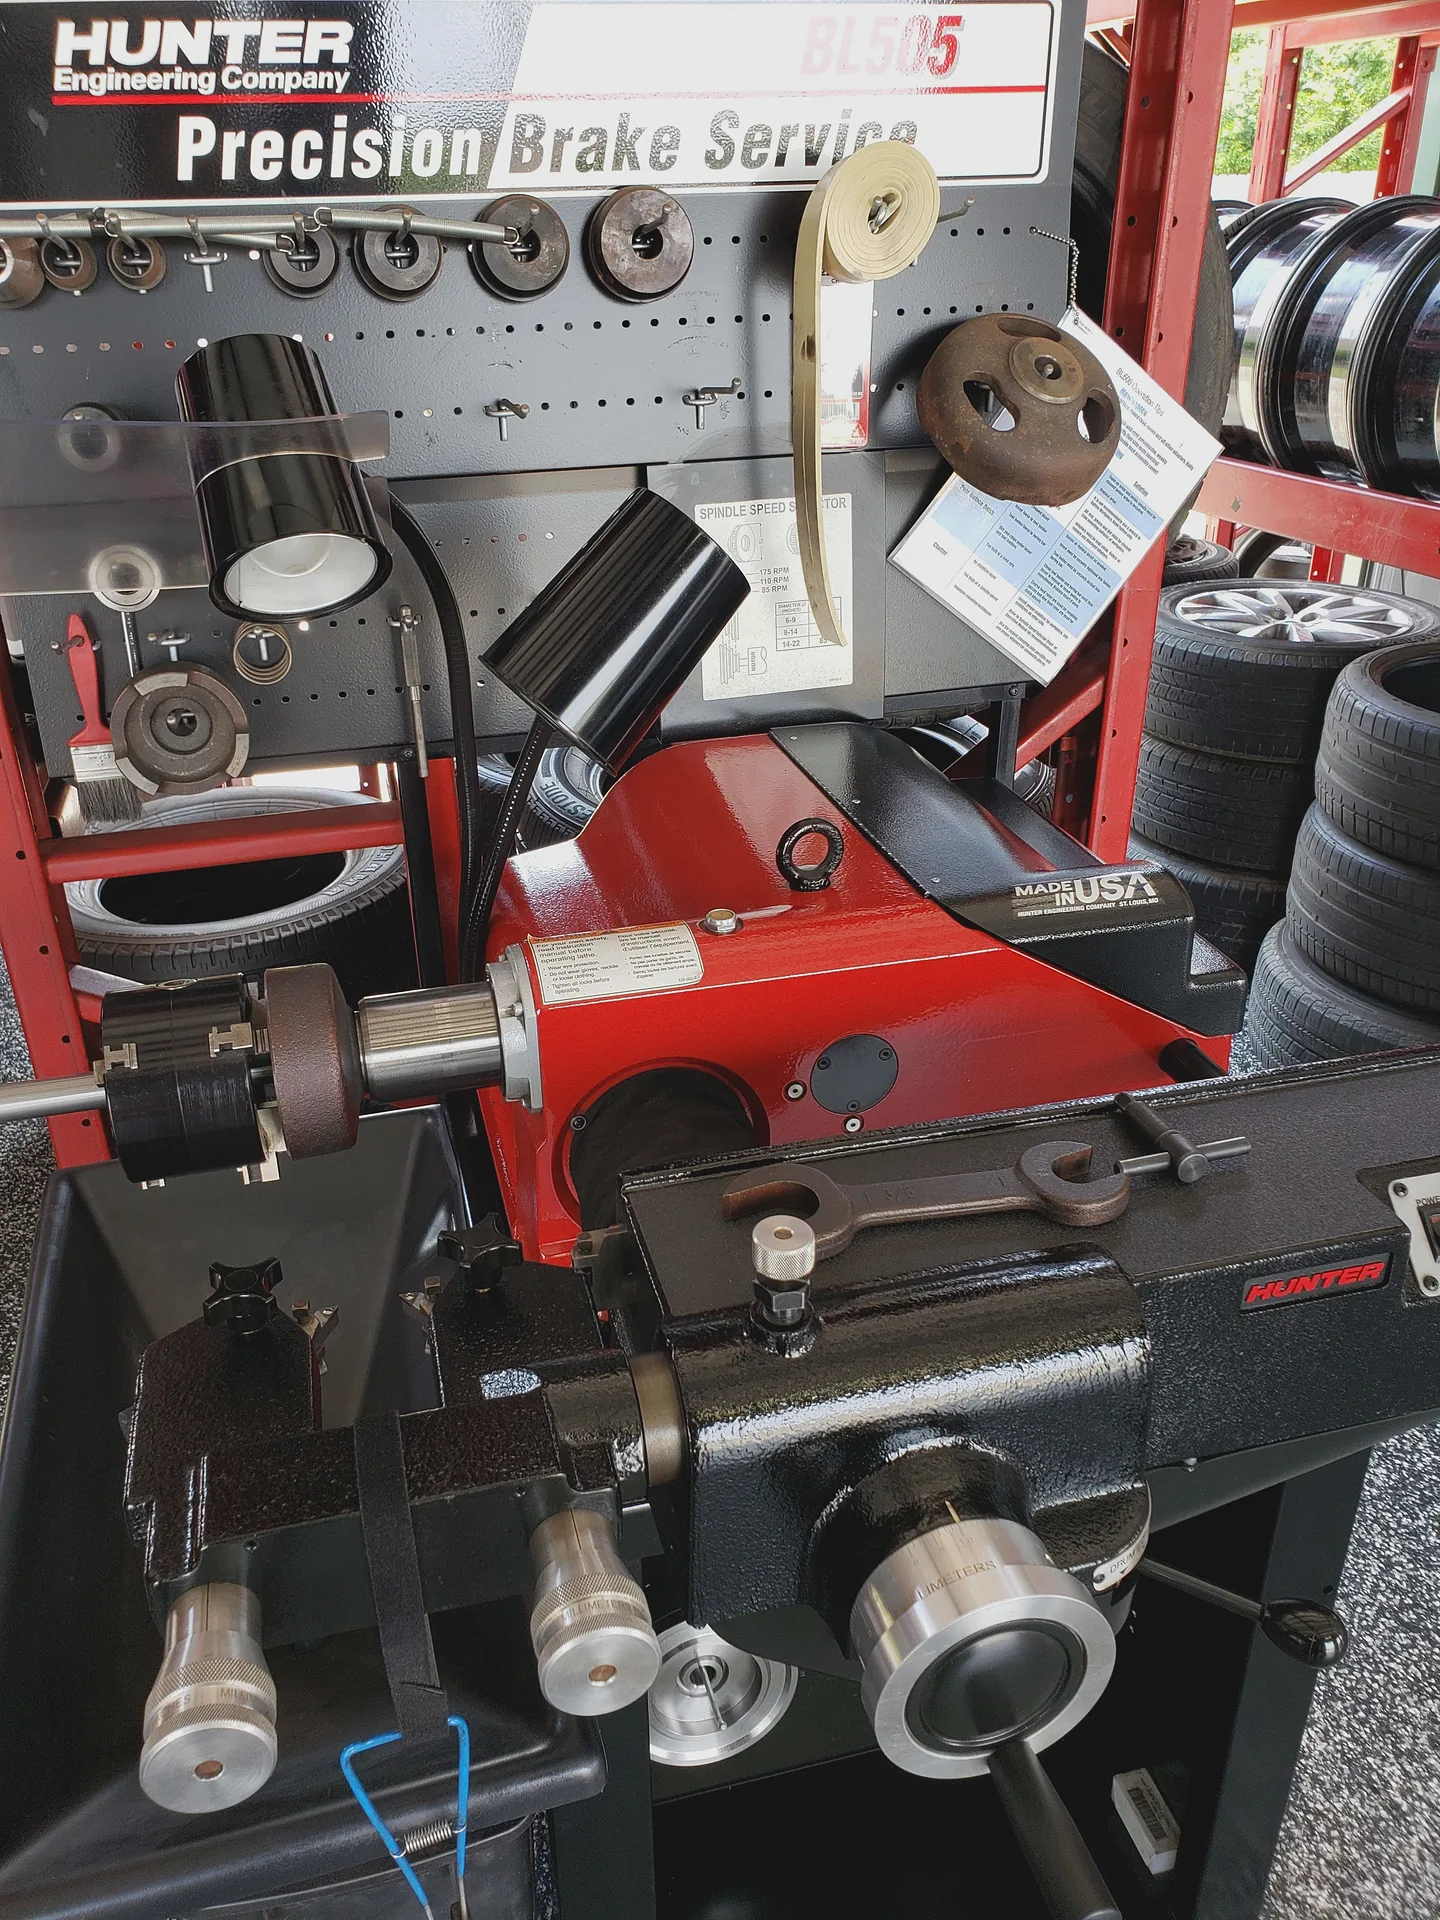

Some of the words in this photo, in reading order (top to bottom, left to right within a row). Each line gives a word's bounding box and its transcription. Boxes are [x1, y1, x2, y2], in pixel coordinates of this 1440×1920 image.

[54, 20, 354, 66] HUNTER
[53, 66, 216, 95] Engineering
[220, 65, 350, 94] Company
[178, 114, 480, 182] Precision
[509, 112, 681, 174] Brake
[700, 505, 746, 519] SPINDLE
[750, 503, 786, 515] SPEED
[789, 497, 846, 512] STOR
[773, 567, 789, 575] RPM
[773, 576, 789, 584] RPM
[1015, 882, 1073, 897] MADE
[1055, 892, 1075, 906] IN
[1074, 874, 1157, 903] USA
[1043, 906, 1085, 915] ENGINEERING
[1086, 902, 1116, 911] COMPANY
[540, 950, 566, 958] manual
[556, 942, 594, 951] instruction
[541, 955, 575, 964] operating
[1245, 1262, 1385, 1303] HUNTER
